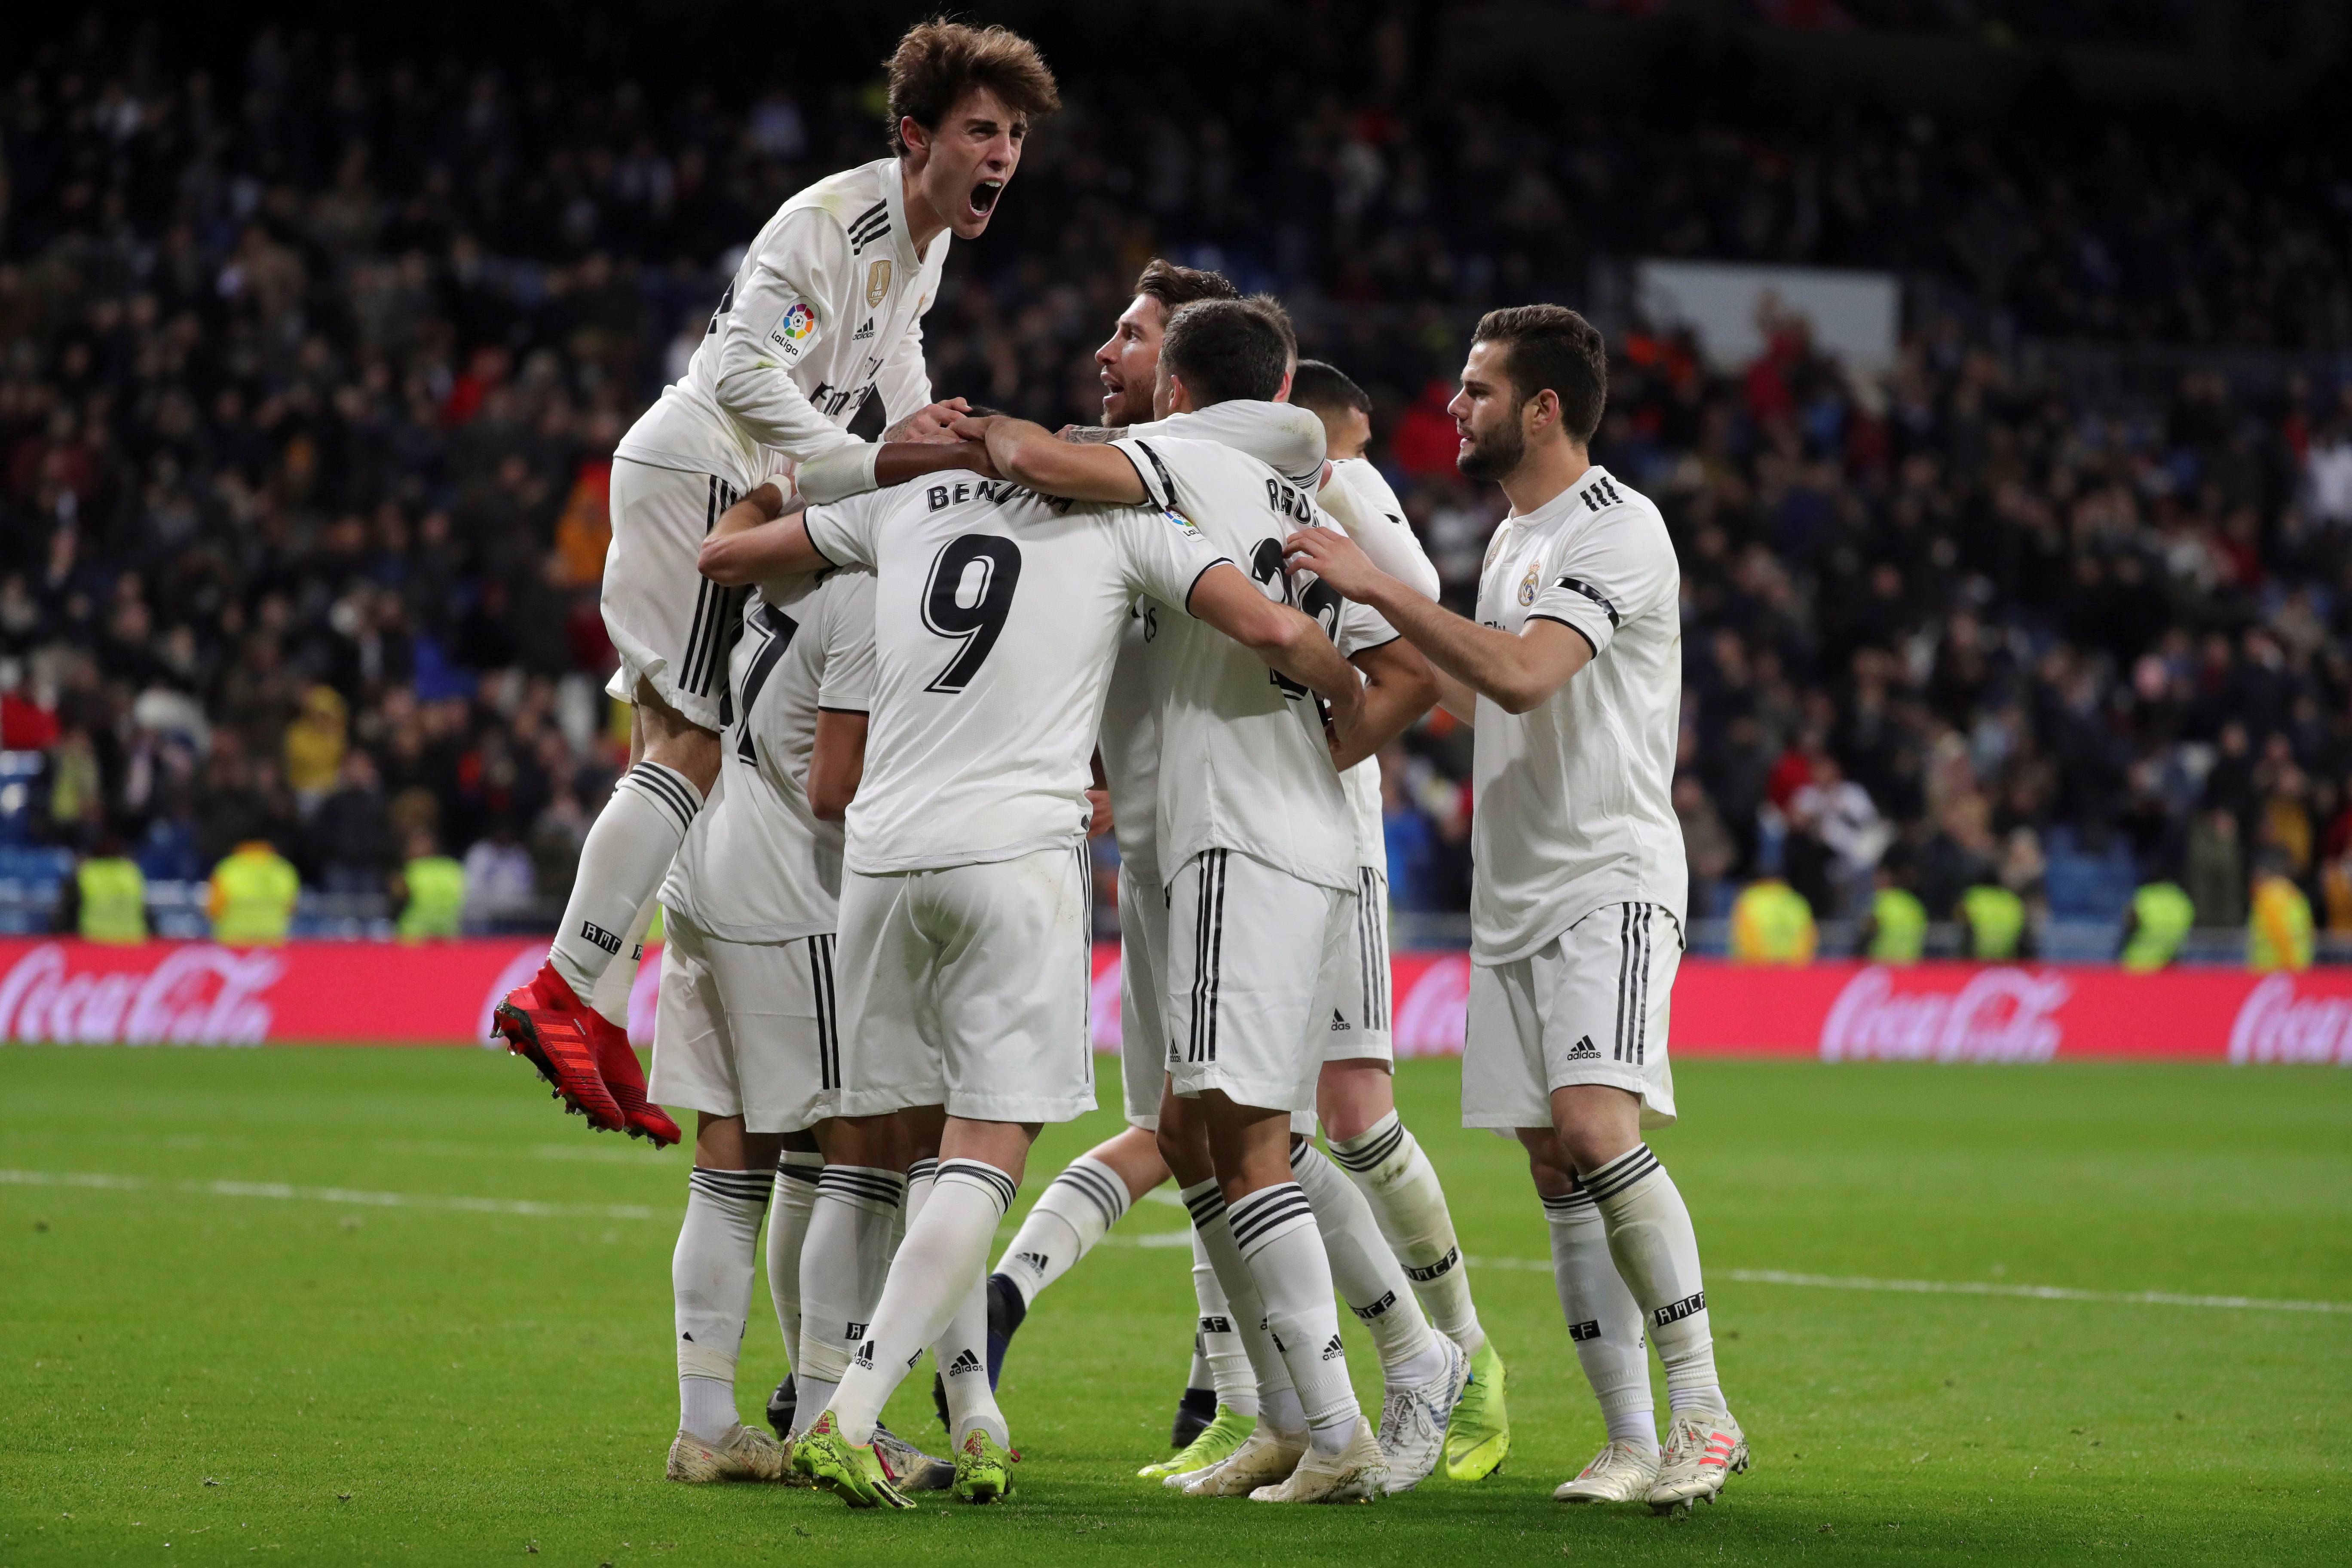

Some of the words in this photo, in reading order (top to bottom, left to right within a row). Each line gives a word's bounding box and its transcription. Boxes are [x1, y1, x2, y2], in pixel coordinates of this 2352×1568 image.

[852, 331, 875, 340] adidas
[771, 330, 799, 356] LaLiga
[1183, 528, 1200, 537] LaL
[920, 533, 1022, 694] 9
[720, 584, 799, 767] 7
[585, 923, 621, 953] RMC
[1331, 1023, 1351, 1031] das
[1567, 1050, 1602, 1061] adidas
[1658, 1292, 1705, 1324] RMCF
[1200, 1317, 1223, 1332] CF
[1323, 1349, 1344, 1361] adid
[949, 1364, 983, 1377] adidas
